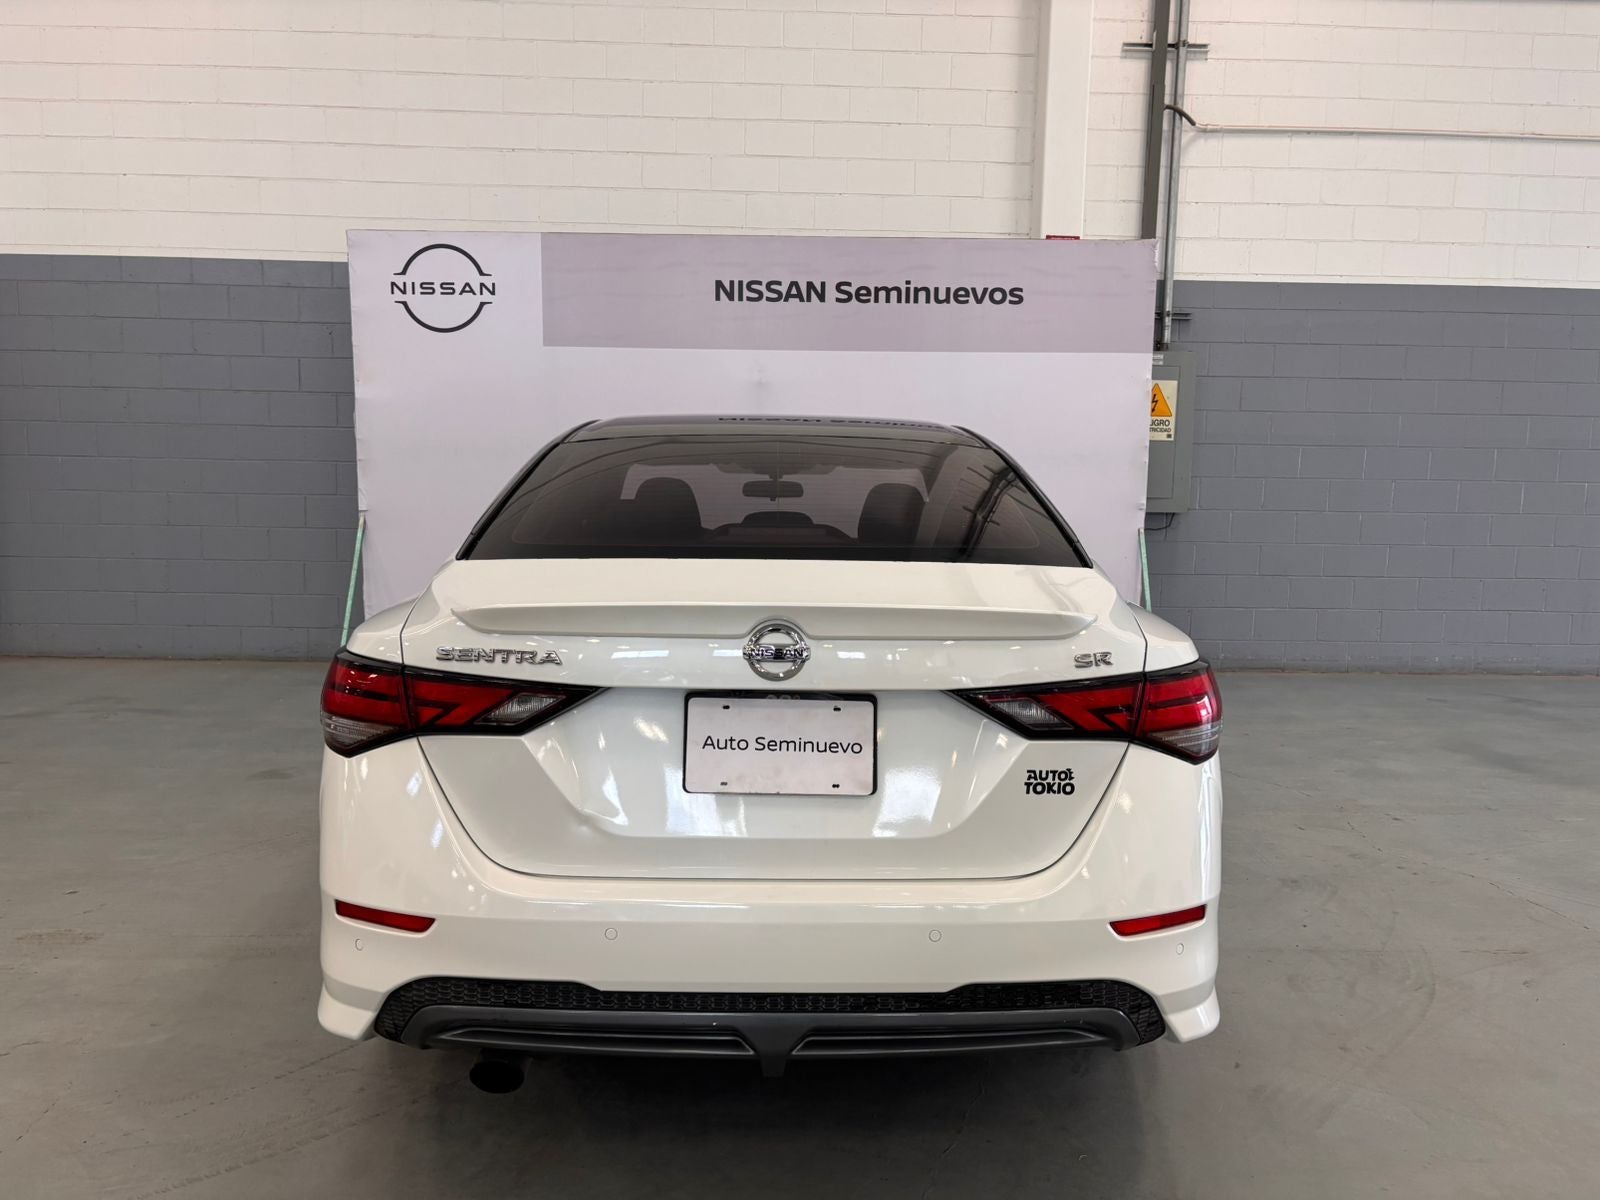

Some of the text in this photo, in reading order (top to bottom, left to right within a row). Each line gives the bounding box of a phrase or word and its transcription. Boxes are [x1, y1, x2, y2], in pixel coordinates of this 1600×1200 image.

[390, 281, 496, 296] NISSAN
[714, 279, 1025, 306] NISSAN Seminuevos
[1149, 419, 1171, 427] IGRO
[436, 646, 563, 665] SENTRA
[750, 647, 805, 658] NISSAN
[1073, 651, 1114, 669] SR
[701, 735, 864, 755] Auto Seminuevo
[1023, 781, 1076, 796] TOKIO
